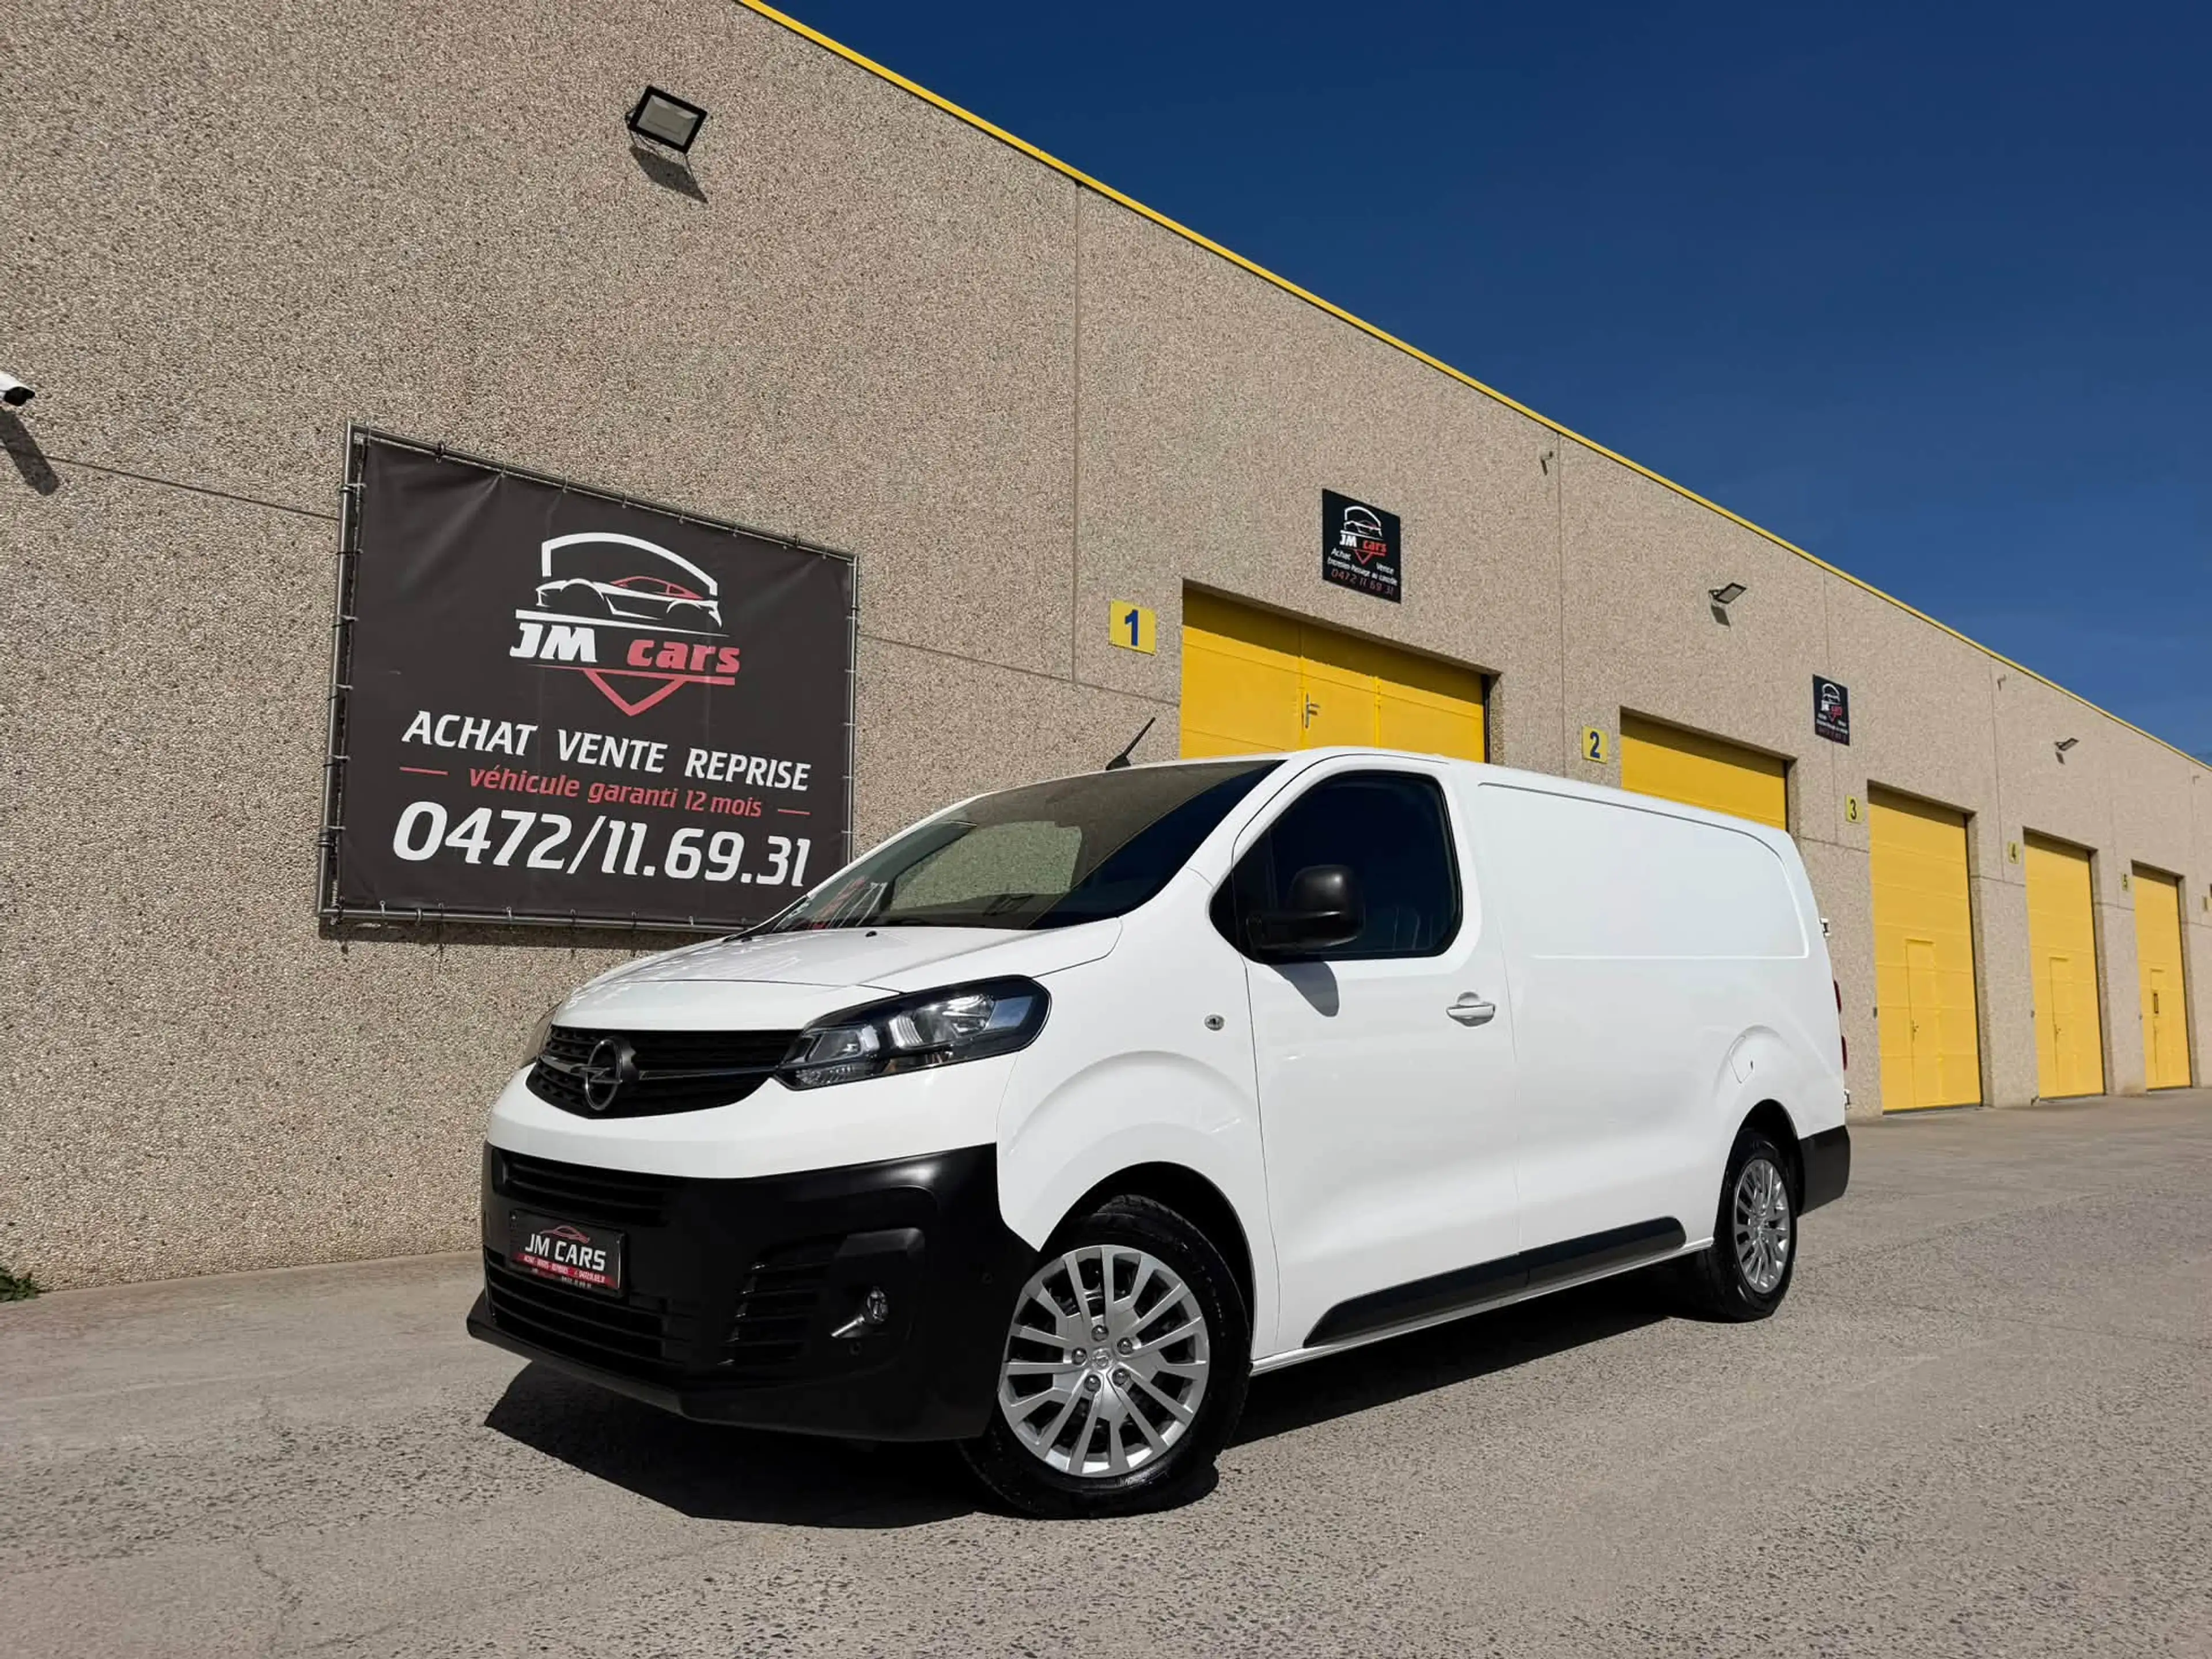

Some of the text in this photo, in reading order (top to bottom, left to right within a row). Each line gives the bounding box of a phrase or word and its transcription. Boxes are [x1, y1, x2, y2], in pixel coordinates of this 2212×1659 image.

[1339, 534, 1387, 553] JM cars
[1124, 609, 1139, 646] 1
[509, 622, 740, 673] JM cars
[401, 710, 812, 791] ACHAT VENTE REPRISE
[1590, 730, 1600, 759] 2
[469, 765, 762, 817] véhicule garanti 12 mois
[1850, 798, 1857, 820] 3
[392, 801, 811, 887] 0472/11.69.31
[525, 1233, 550, 1257] JM
[554, 1240, 607, 1271] CARS
